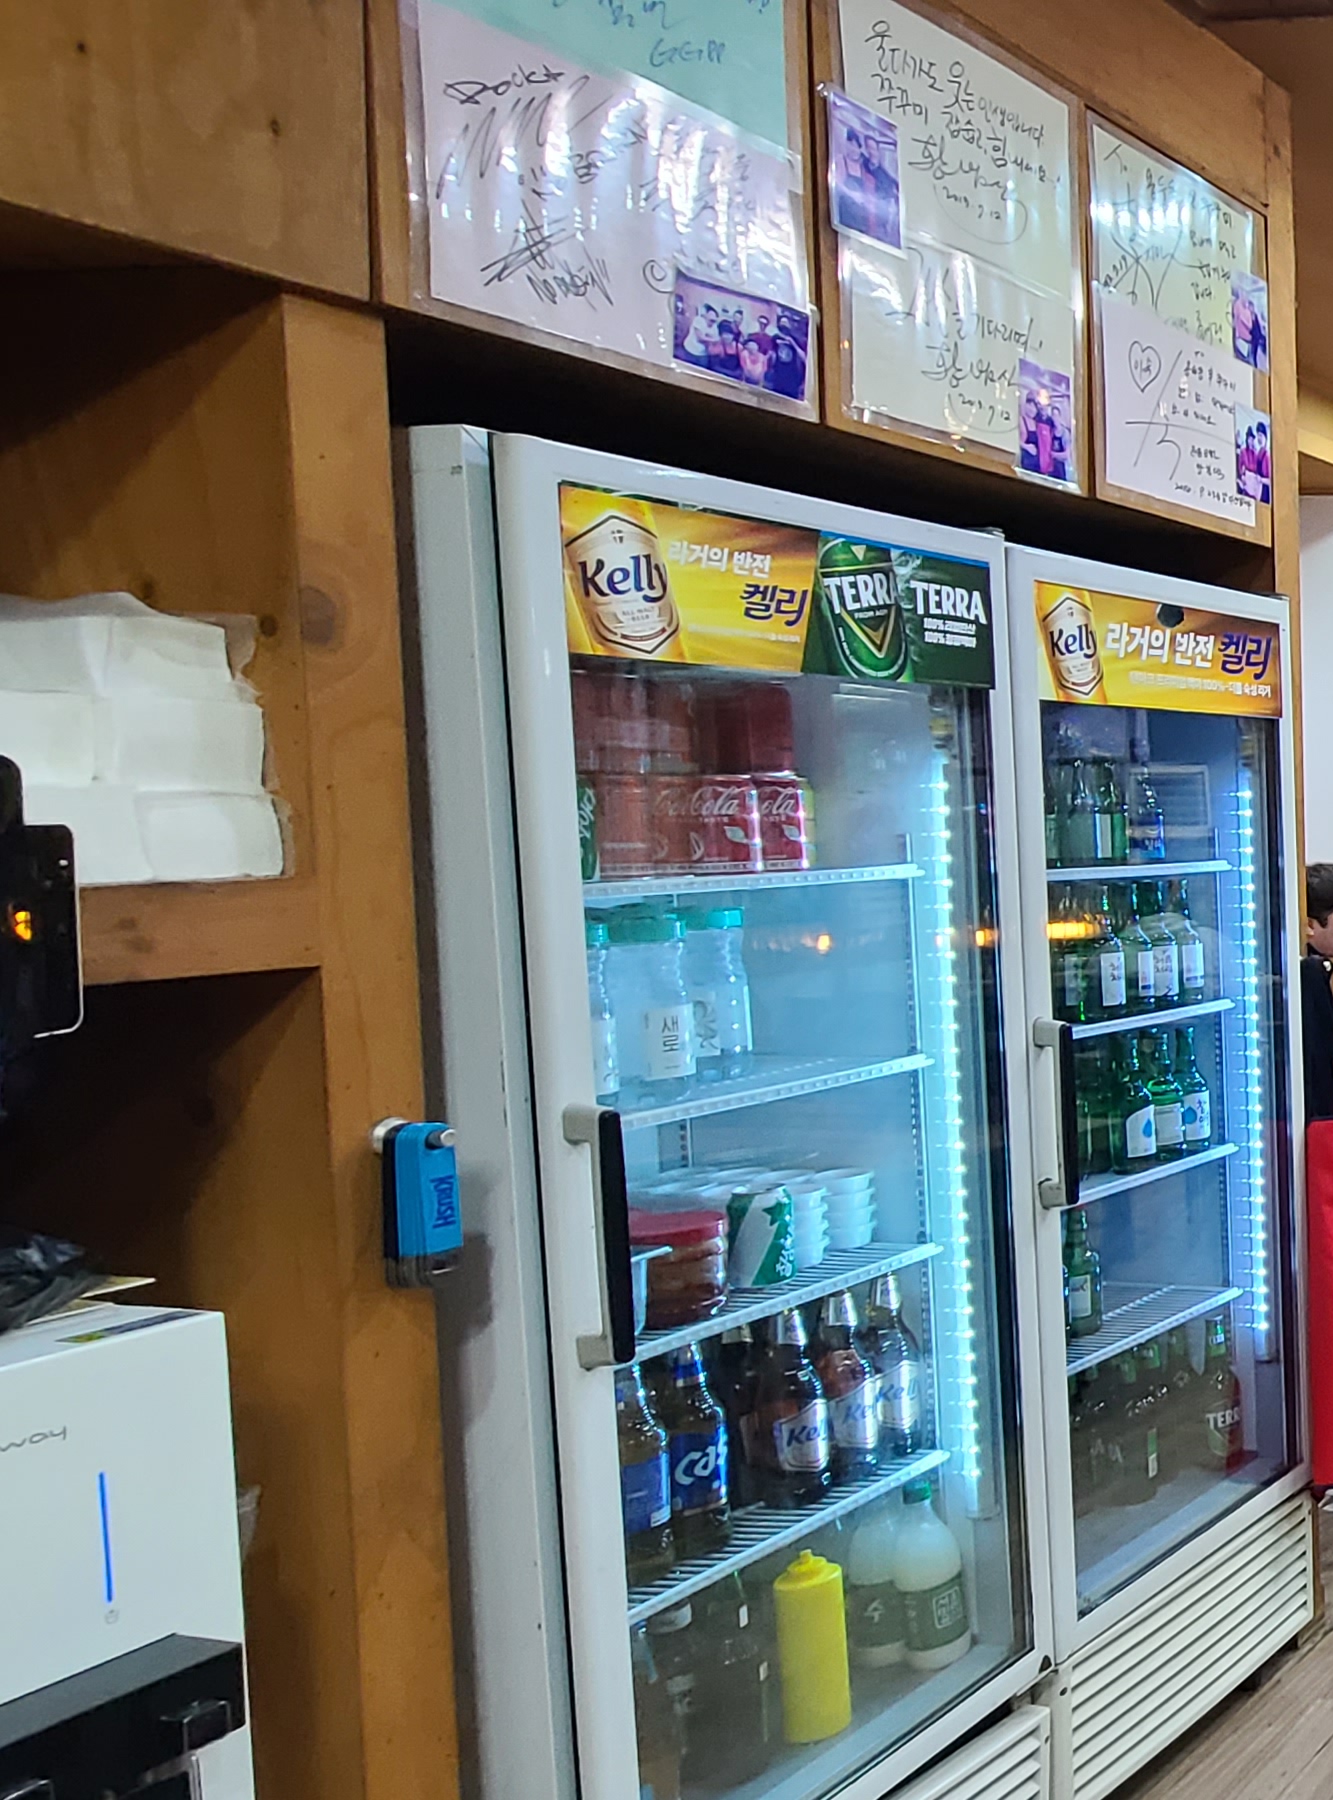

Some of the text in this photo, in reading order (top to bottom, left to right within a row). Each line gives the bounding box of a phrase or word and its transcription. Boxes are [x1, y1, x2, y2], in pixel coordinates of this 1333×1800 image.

[577, 554, 669, 604] Kelly
[668, 540, 771, 579] 라거의 반전
[740, 583, 809, 627] 켈리
[823, 572, 897, 614] TERRA
[910, 580, 987, 624] TERRA
[1050, 623, 1097, 659] Kelly
[1106, 623, 1272, 681] 라거의 반전 켈리
[661, 1014, 680, 1053] 새로
[430, 1174, 457, 1229] KRUSH
